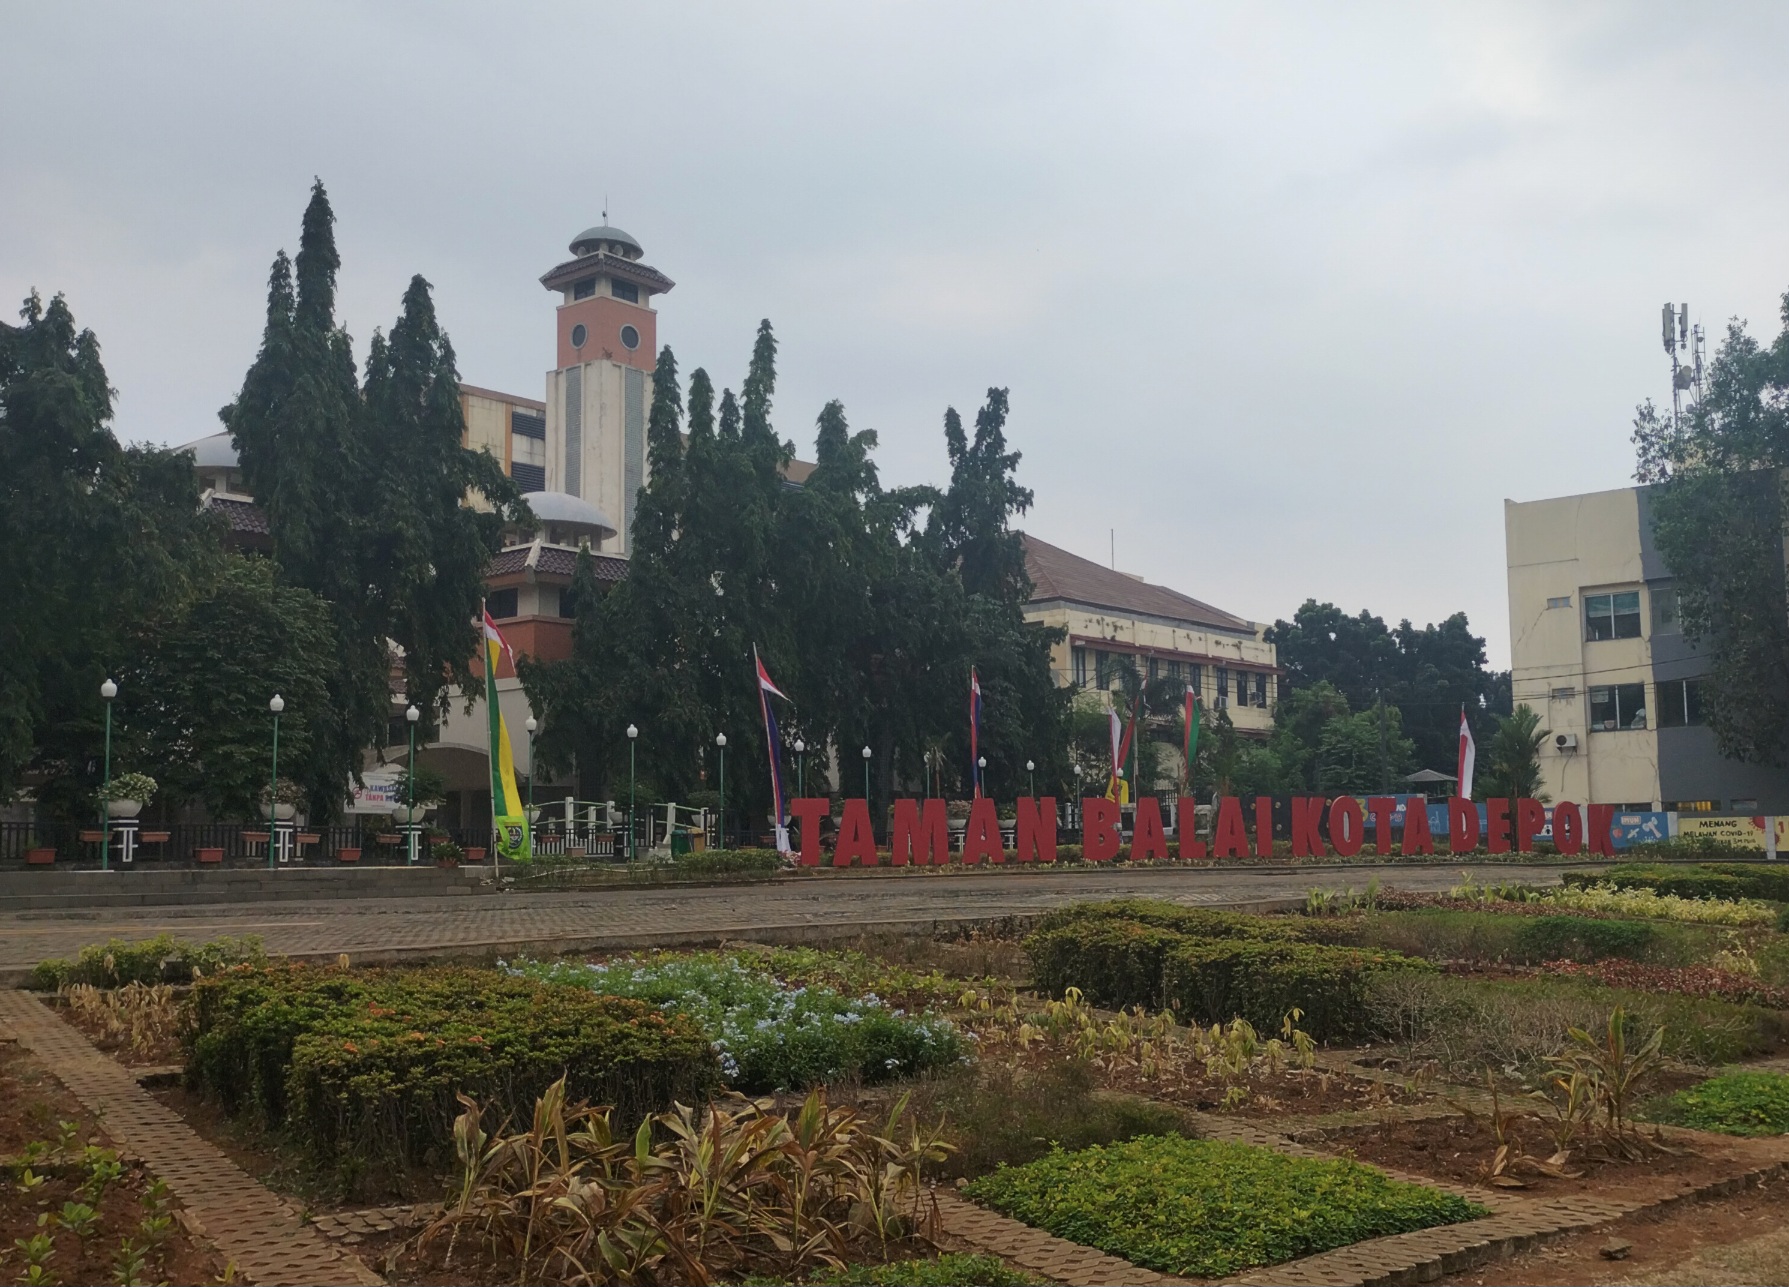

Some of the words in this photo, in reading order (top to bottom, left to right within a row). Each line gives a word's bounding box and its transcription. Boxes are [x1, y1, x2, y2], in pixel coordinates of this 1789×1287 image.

[791, 797, 1056, 865] TAMAN
[1083, 797, 1272, 860] BALAI
[1291, 796, 1434, 857] KOTA
[1448, 797, 1616, 858] DEPOK
[1699, 820, 1738, 829] MENANG
